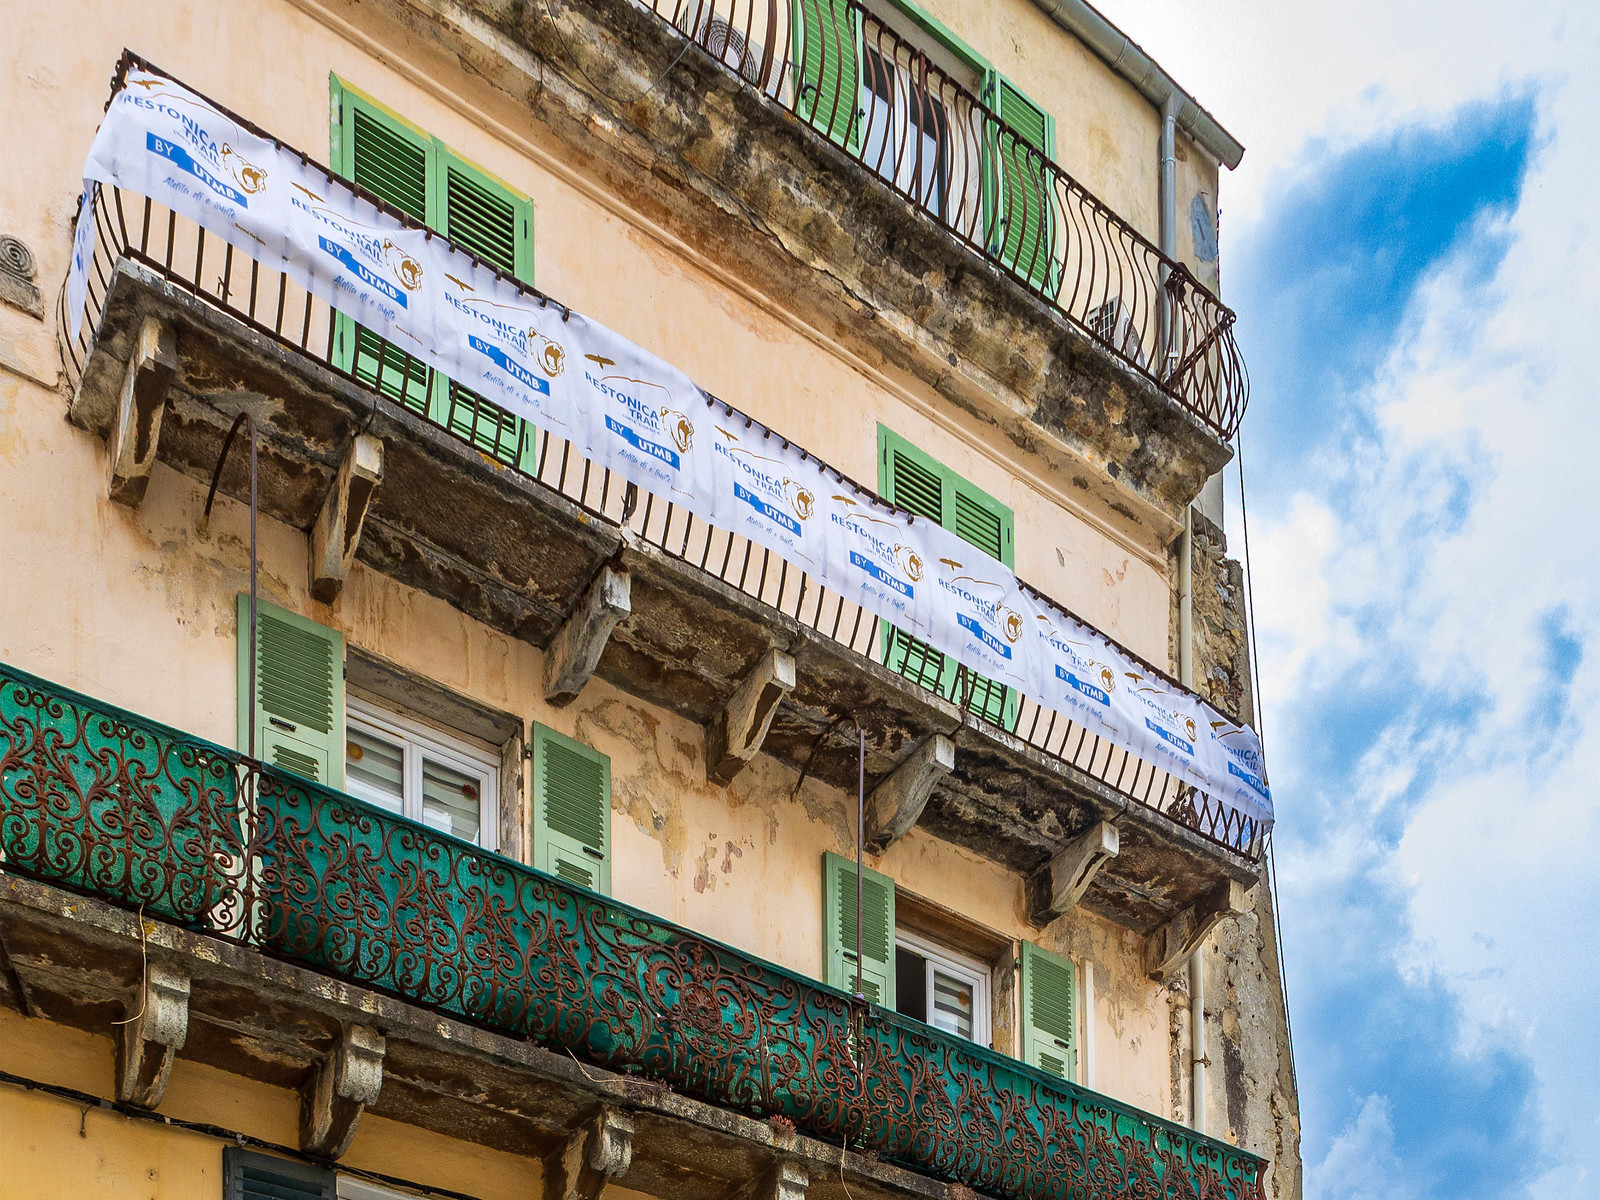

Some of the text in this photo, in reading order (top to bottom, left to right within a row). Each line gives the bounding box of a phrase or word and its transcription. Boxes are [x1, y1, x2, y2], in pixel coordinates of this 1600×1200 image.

[122, 94, 219, 157] RESTONICA
[154, 139, 173, 156] BY
[183, 126, 220, 167] TRAIL
[192, 162, 236, 200] UTMB
[291, 196, 382, 253] RESTONICA
[326, 240, 342, 258] BY
[350, 236, 383, 264] TRAIL
[358, 266, 396, 298] UTMB
[444, 292, 528, 342] RESTONICA
[475, 339, 491, 354] BY
[494, 328, 528, 354] TRAIL
[506, 358, 540, 390] UTMB
[584, 370, 660, 422] RESTONICA
[610, 420, 625, 434] BY
[629, 408, 660, 430] TRAIL
[638, 439, 672, 462] UTMB
[714, 442, 783, 490] RESTONICA
[738, 488, 752, 501] BY
[754, 478, 783, 499] TRAIL
[764, 506, 795, 530] UTMB
[831, 513, 894, 557] RESTONICA
[854, 554, 868, 567] BY
[871, 543, 896, 563] TRAIL
[878, 570, 907, 592] UTMB
[938, 578, 996, 616] RESTONICA
[961, 616, 974, 628] BY
[974, 604, 996, 623] TRAIL
[1060, 667, 1070, 680] BY
[1078, 682, 1104, 701] UTMB
